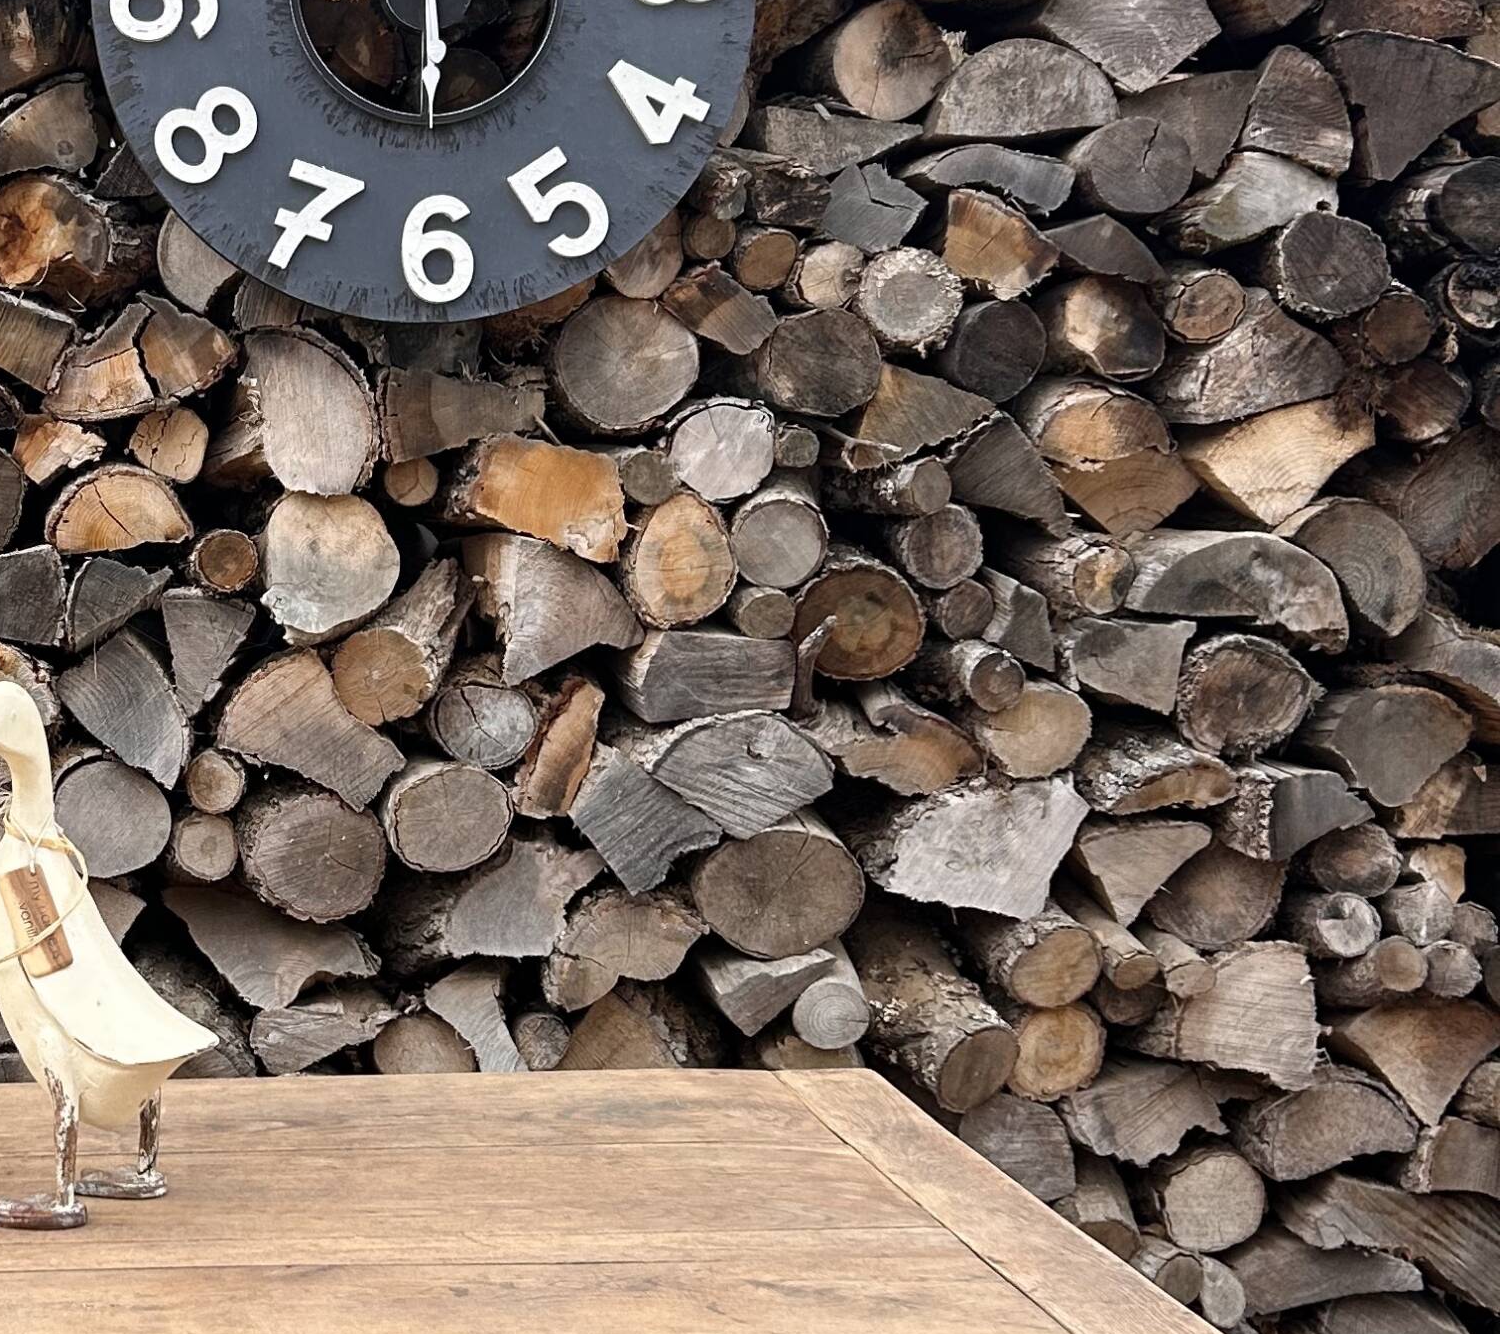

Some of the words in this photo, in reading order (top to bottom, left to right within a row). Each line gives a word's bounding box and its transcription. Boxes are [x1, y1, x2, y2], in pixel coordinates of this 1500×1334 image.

[154, 86, 258, 184] 8
[606, 59, 711, 144] 4
[267, 158, 366, 270] 7
[400, 194, 475, 304] 6
[506, 146, 609, 257] 5
[28, 879, 41, 901] my
